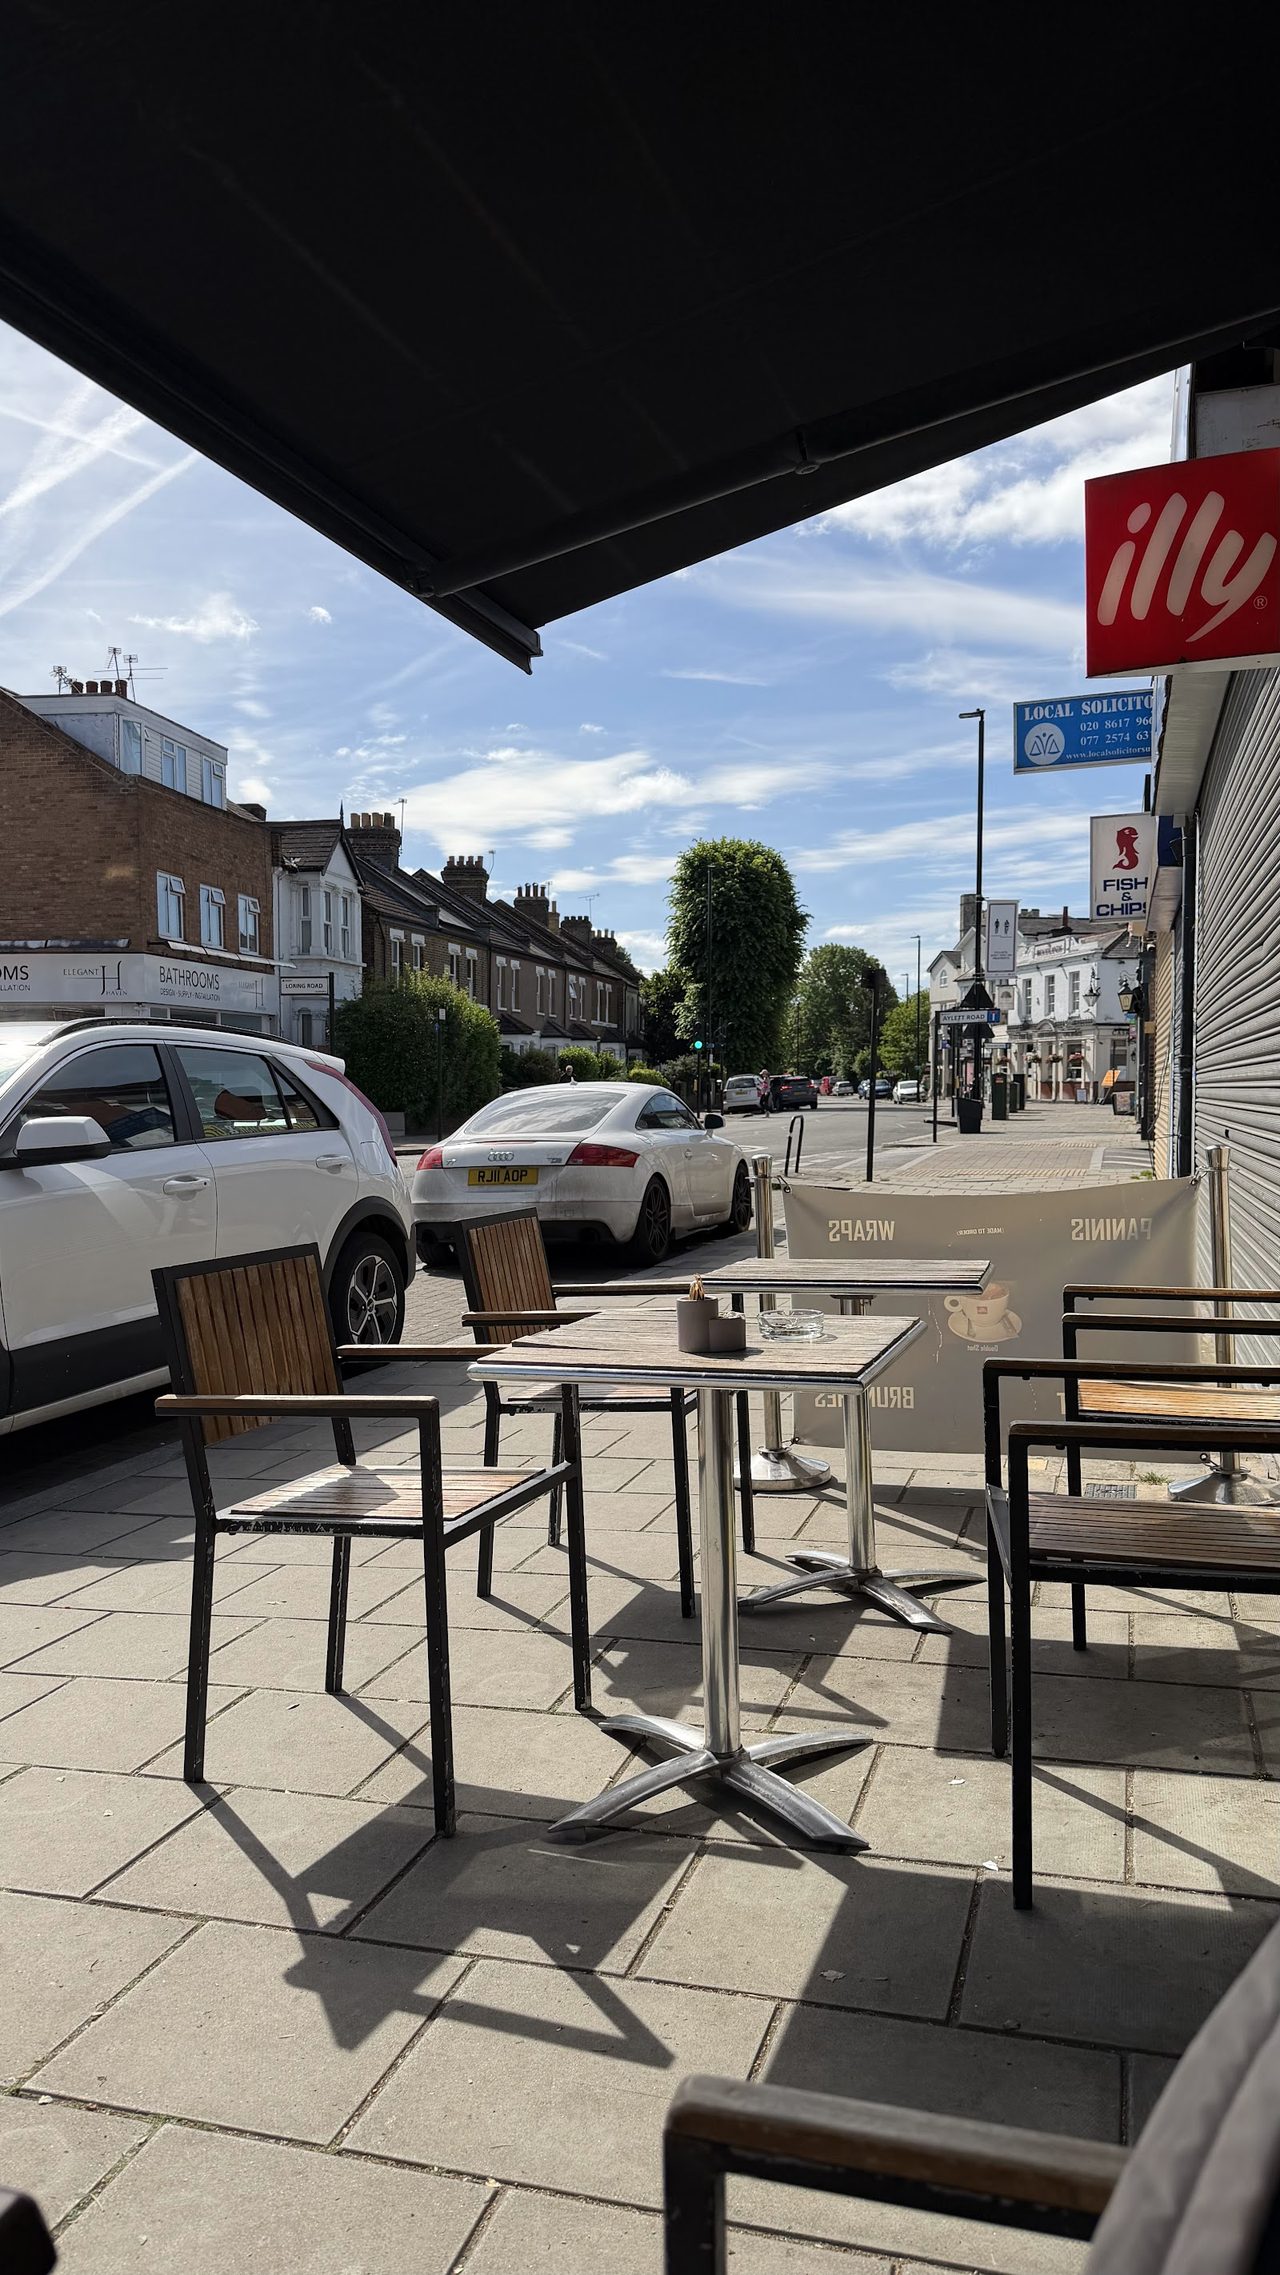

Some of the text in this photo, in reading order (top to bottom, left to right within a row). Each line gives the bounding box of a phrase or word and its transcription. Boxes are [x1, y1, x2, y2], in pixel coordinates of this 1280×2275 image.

[1097, 491, 1277, 643] illy
[1024, 703, 1074, 721] LOCAL
[1080, 721, 1099, 732] 020
[1105, 718, 1130, 729] 8617
[1080, 730, 1152, 746] 077 2574 63
[1103, 877, 1148, 892] FISH
[1121, 892, 1132, 901] &
[63, 968, 99, 976] ELEGANT
[160, 966, 220, 991] BATHROOMS
[160, 987, 175, 996] DESIGN
[478, 1169, 528, 1183] RJ11 AOP
